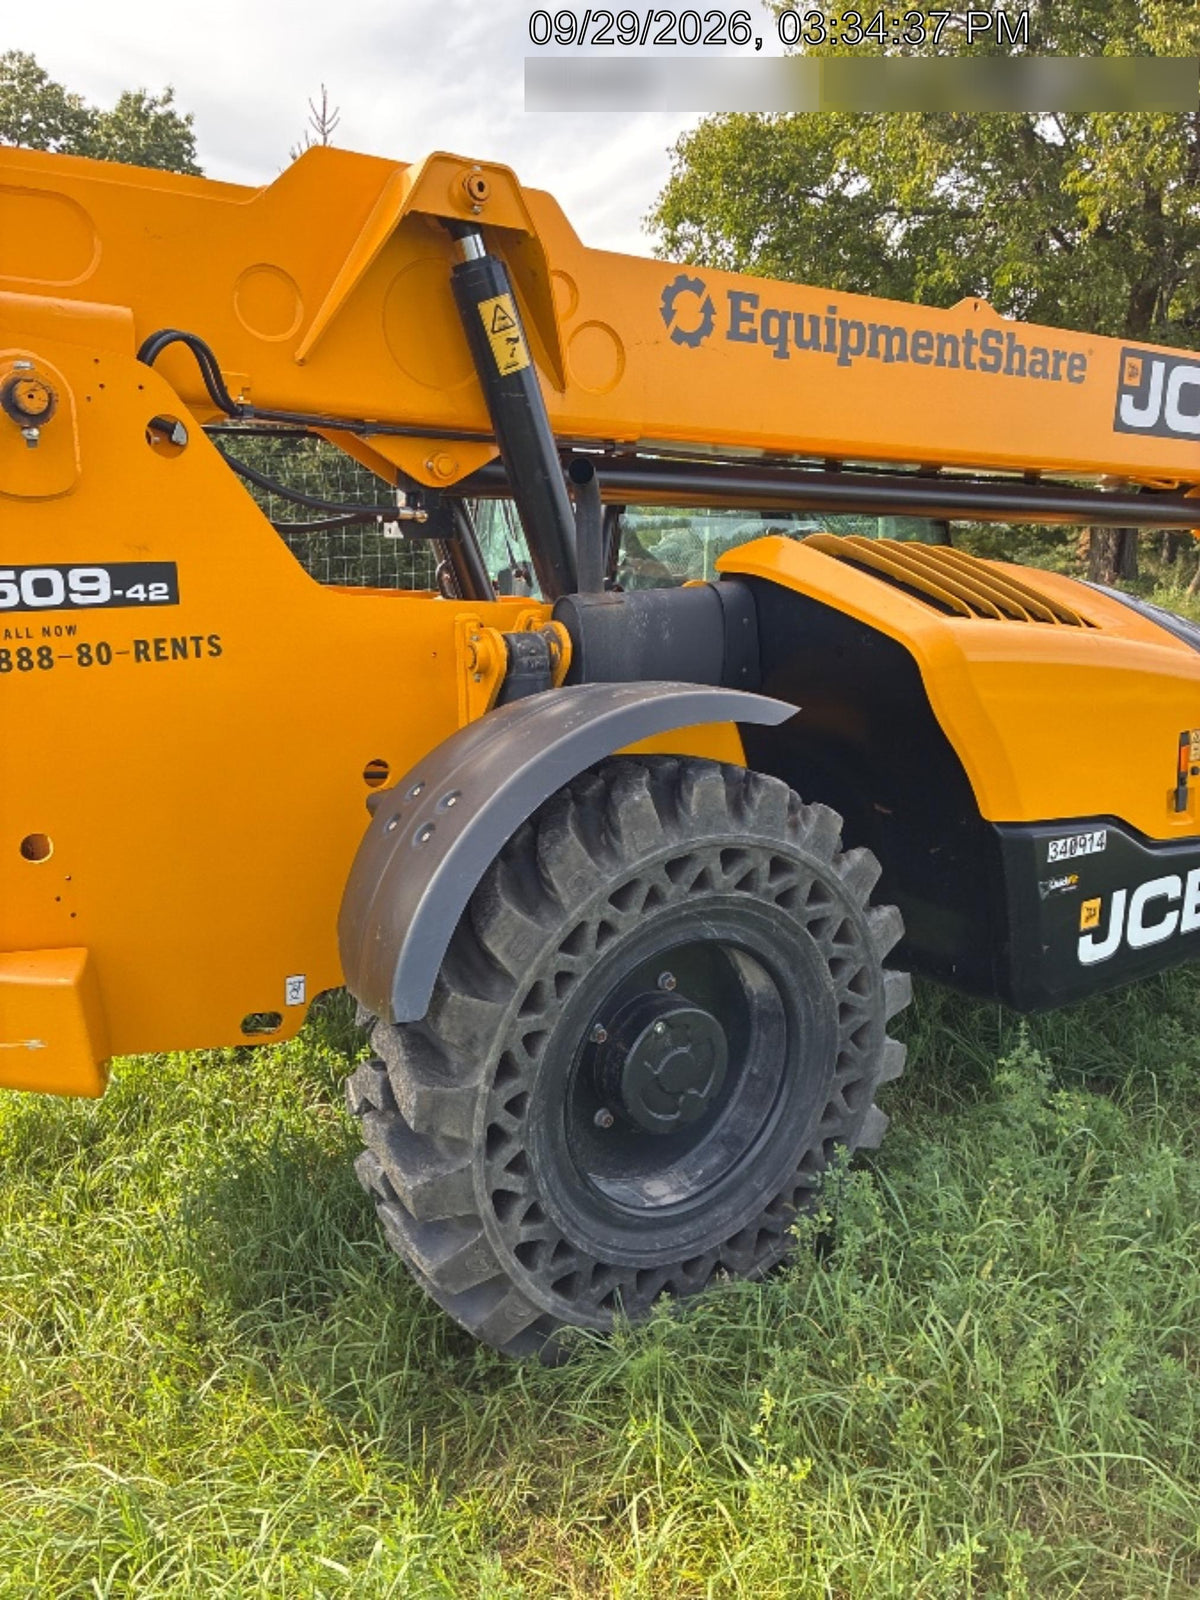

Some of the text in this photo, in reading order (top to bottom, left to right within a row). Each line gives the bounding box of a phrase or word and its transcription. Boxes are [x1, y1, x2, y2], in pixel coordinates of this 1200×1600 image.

[726, 290, 1088, 384] EquipmentShare
[42, 624, 78, 638] NOW
[1049, 831, 1106, 861] 340914
